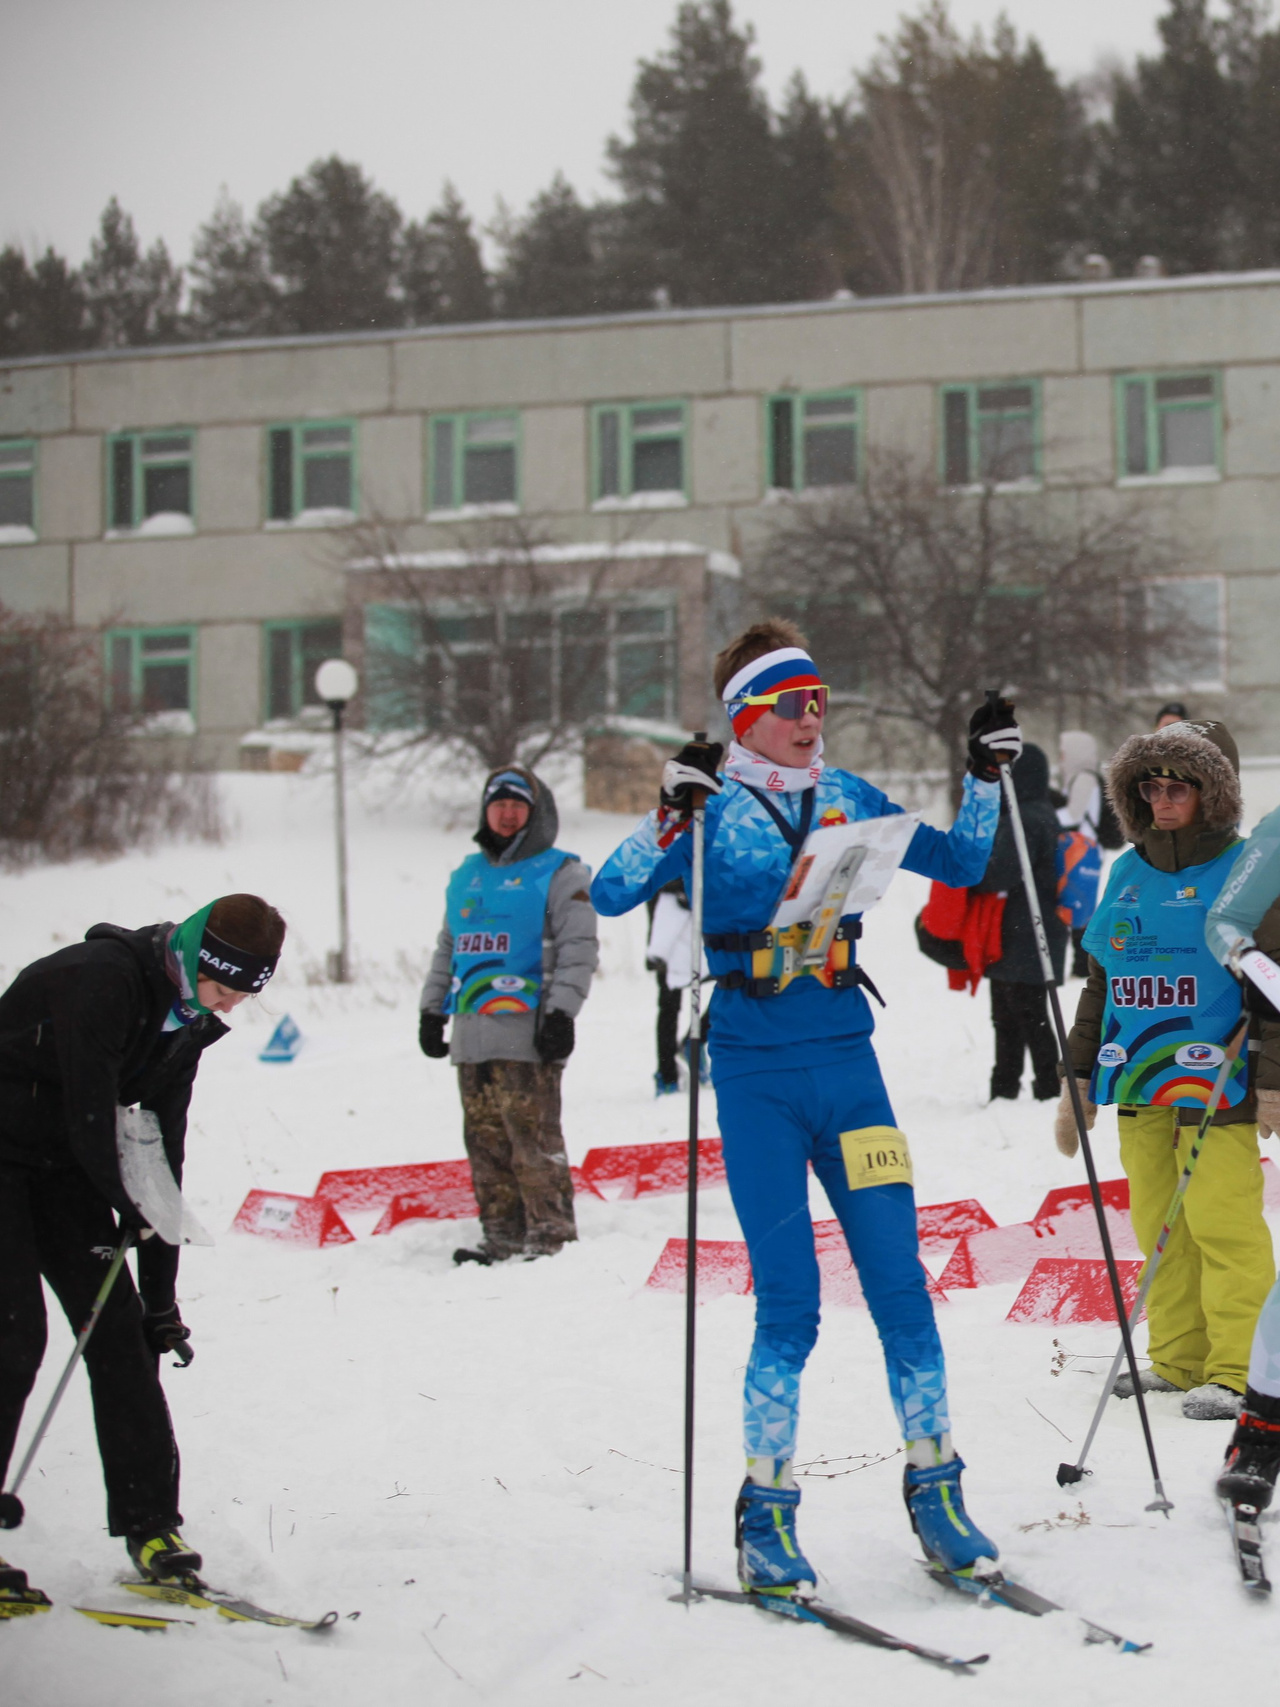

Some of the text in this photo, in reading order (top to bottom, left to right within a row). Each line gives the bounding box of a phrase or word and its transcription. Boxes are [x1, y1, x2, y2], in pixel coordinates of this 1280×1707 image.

[1212, 848, 1263, 913] NORDSK
[199, 949, 243, 976] RAFT
[1126, 955, 1150, 963] SPORT
[1154, 947, 1197, 955] TOGETHER
[1111, 975, 1197, 1010] СУДЬЯ
